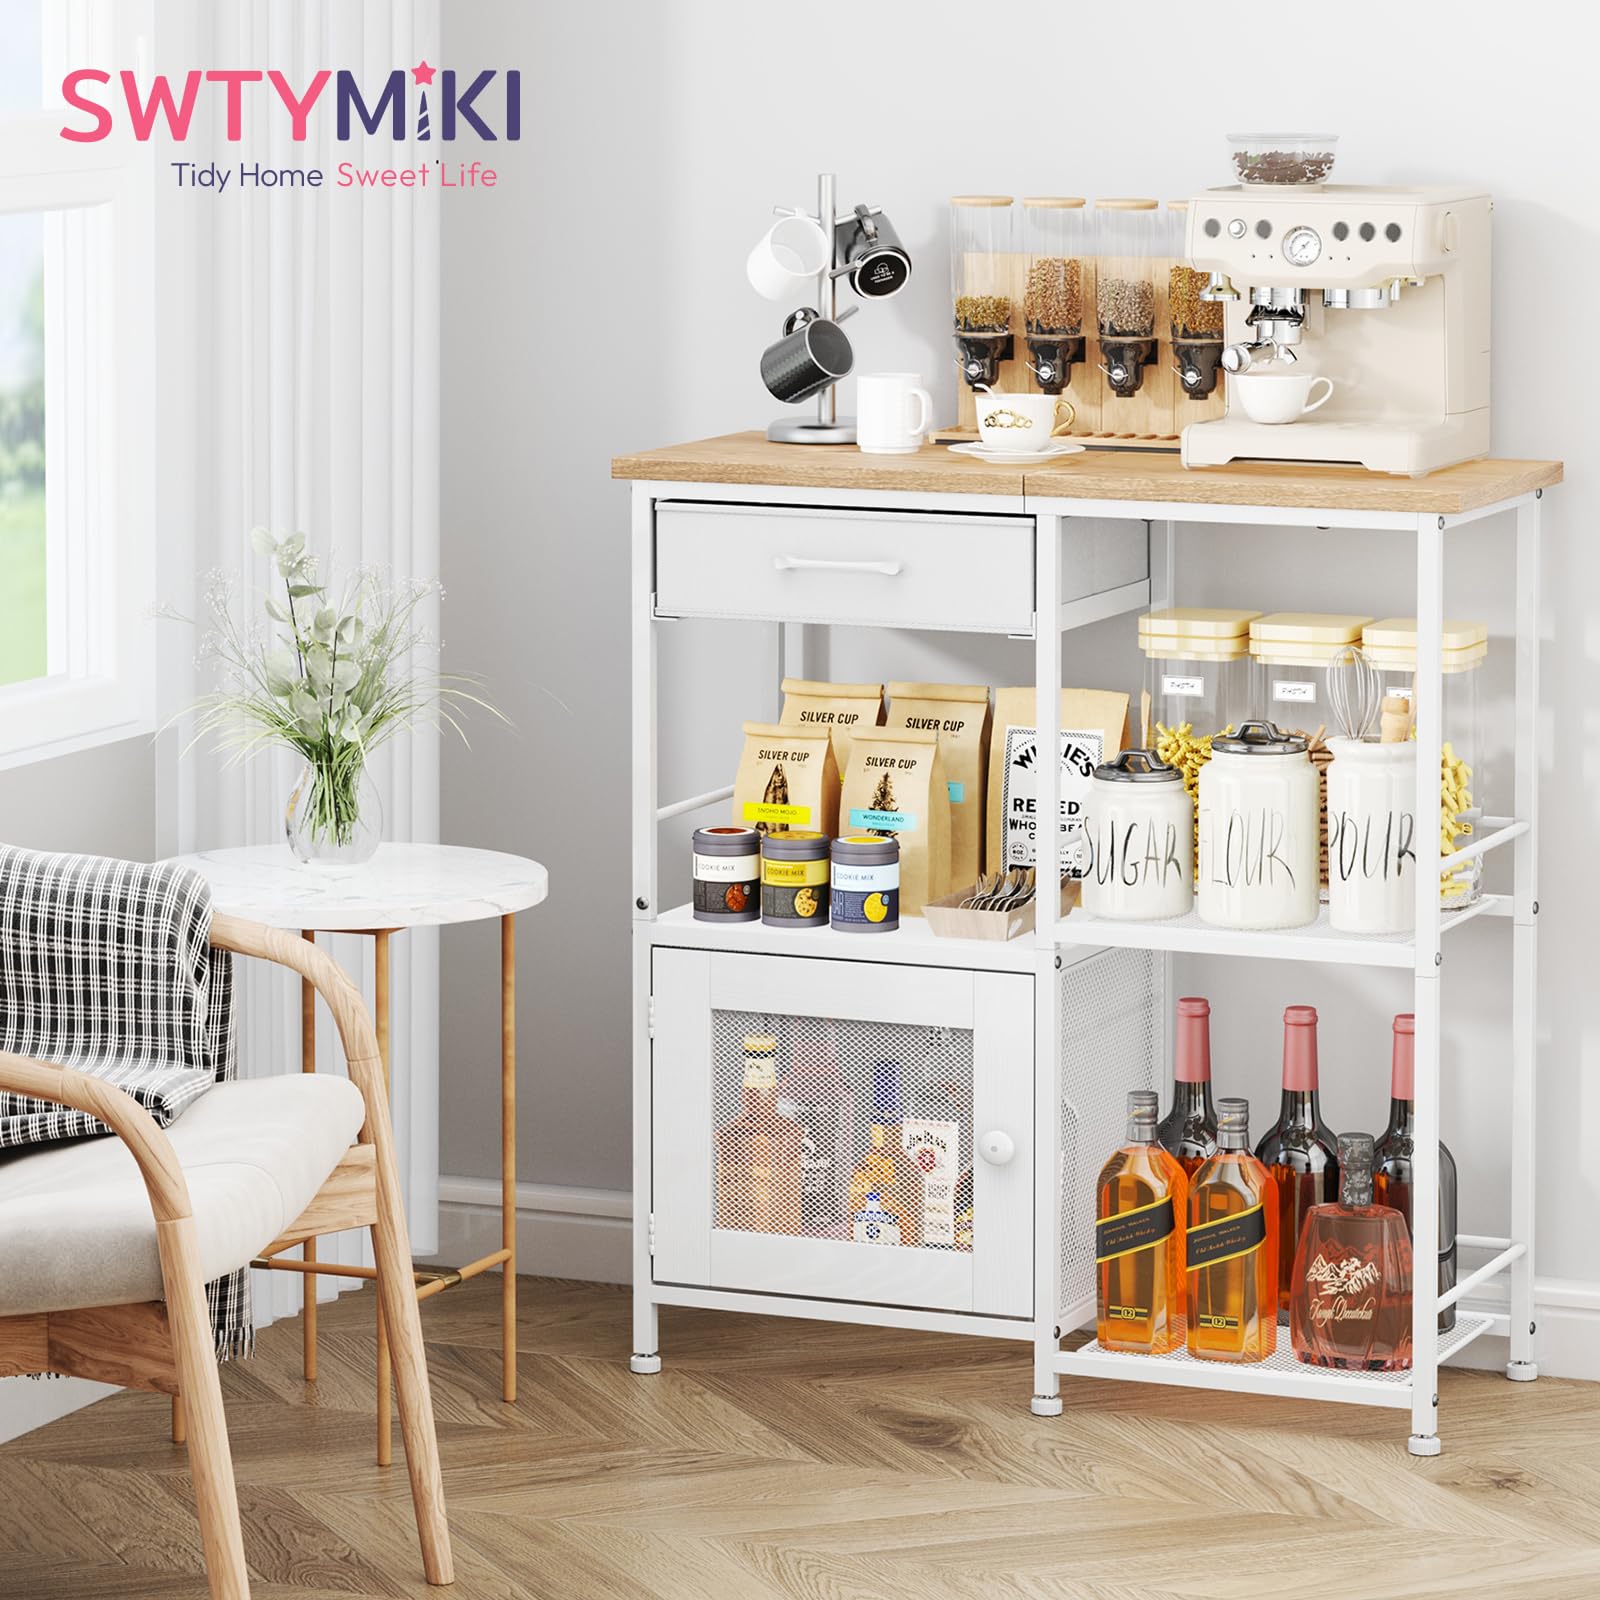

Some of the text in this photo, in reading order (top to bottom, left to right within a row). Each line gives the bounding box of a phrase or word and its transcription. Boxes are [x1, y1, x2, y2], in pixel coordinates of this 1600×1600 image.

[800, 711, 859, 726] SILVER CUP
[905, 717, 965, 732] SILVER CUP
[758, 749, 810, 763] SILVER CUP
[865, 756, 917, 770] SILVER CUP
[863, 814, 905, 823] WONDERLAND
[1082, 816, 1182, 889] SUGAR
[698, 863, 736, 872] COOKIE MIX
[766, 867, 805, 877] COOKIE MIX
[836, 872, 874, 881] COOKIE MIX
[1124, 1309, 1133, 1317] 12
[1214, 1318, 1224, 1326] 12
